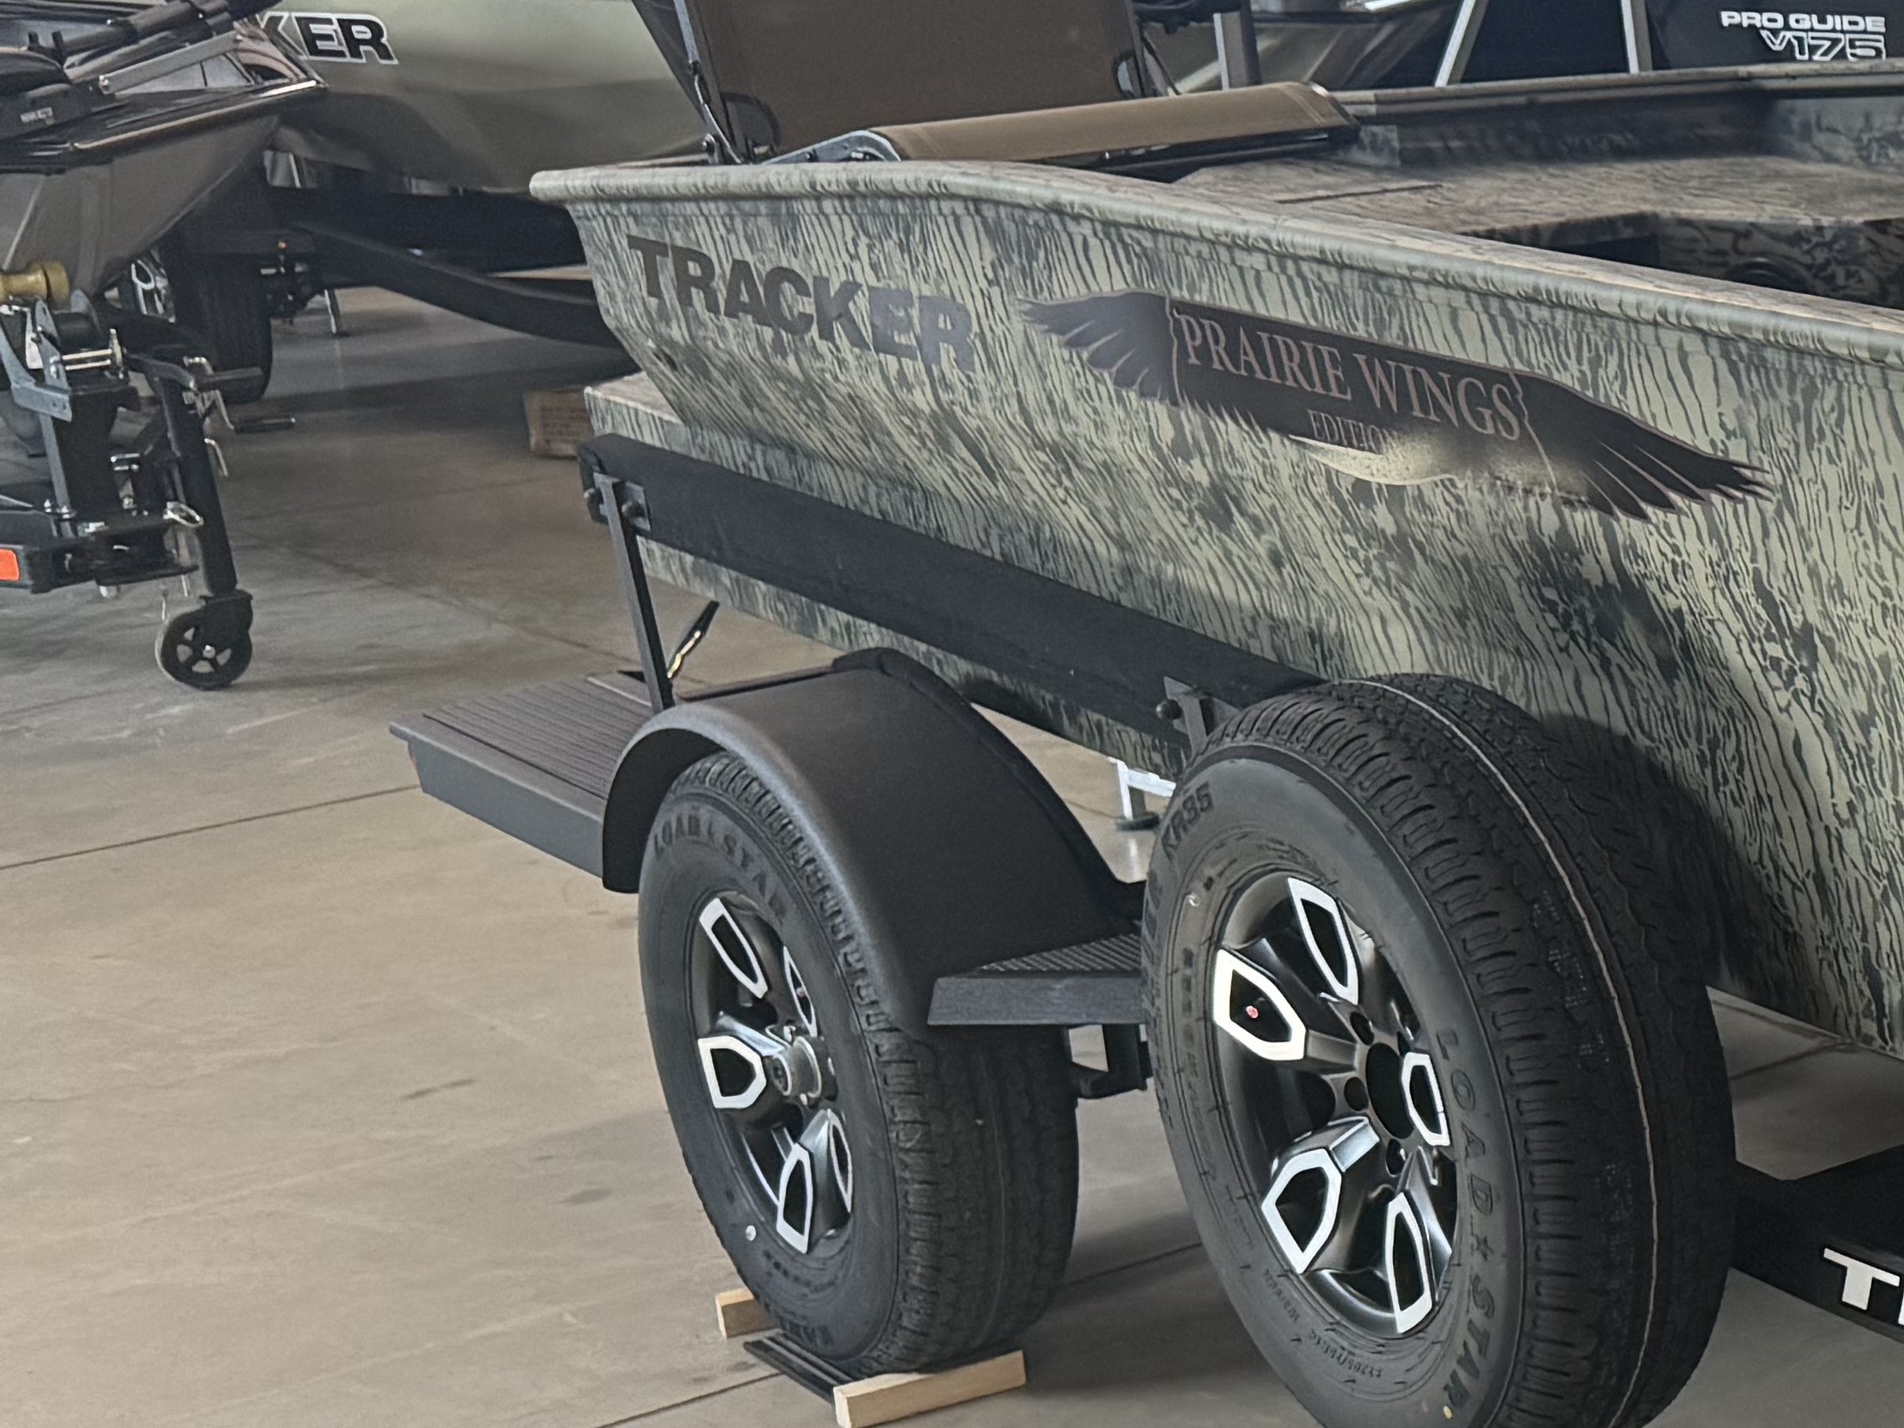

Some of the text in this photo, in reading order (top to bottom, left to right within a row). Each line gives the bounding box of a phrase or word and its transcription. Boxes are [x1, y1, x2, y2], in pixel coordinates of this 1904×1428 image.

[1720, 10, 1887, 33] PRO GUIDE
[1758, 29, 1887, 62] V175
[626, 233, 976, 373] TRACKER
[1173, 309, 1521, 441] PRAIRIE WINGS
[1436, 1027, 1496, 1409] LOAD STAR
